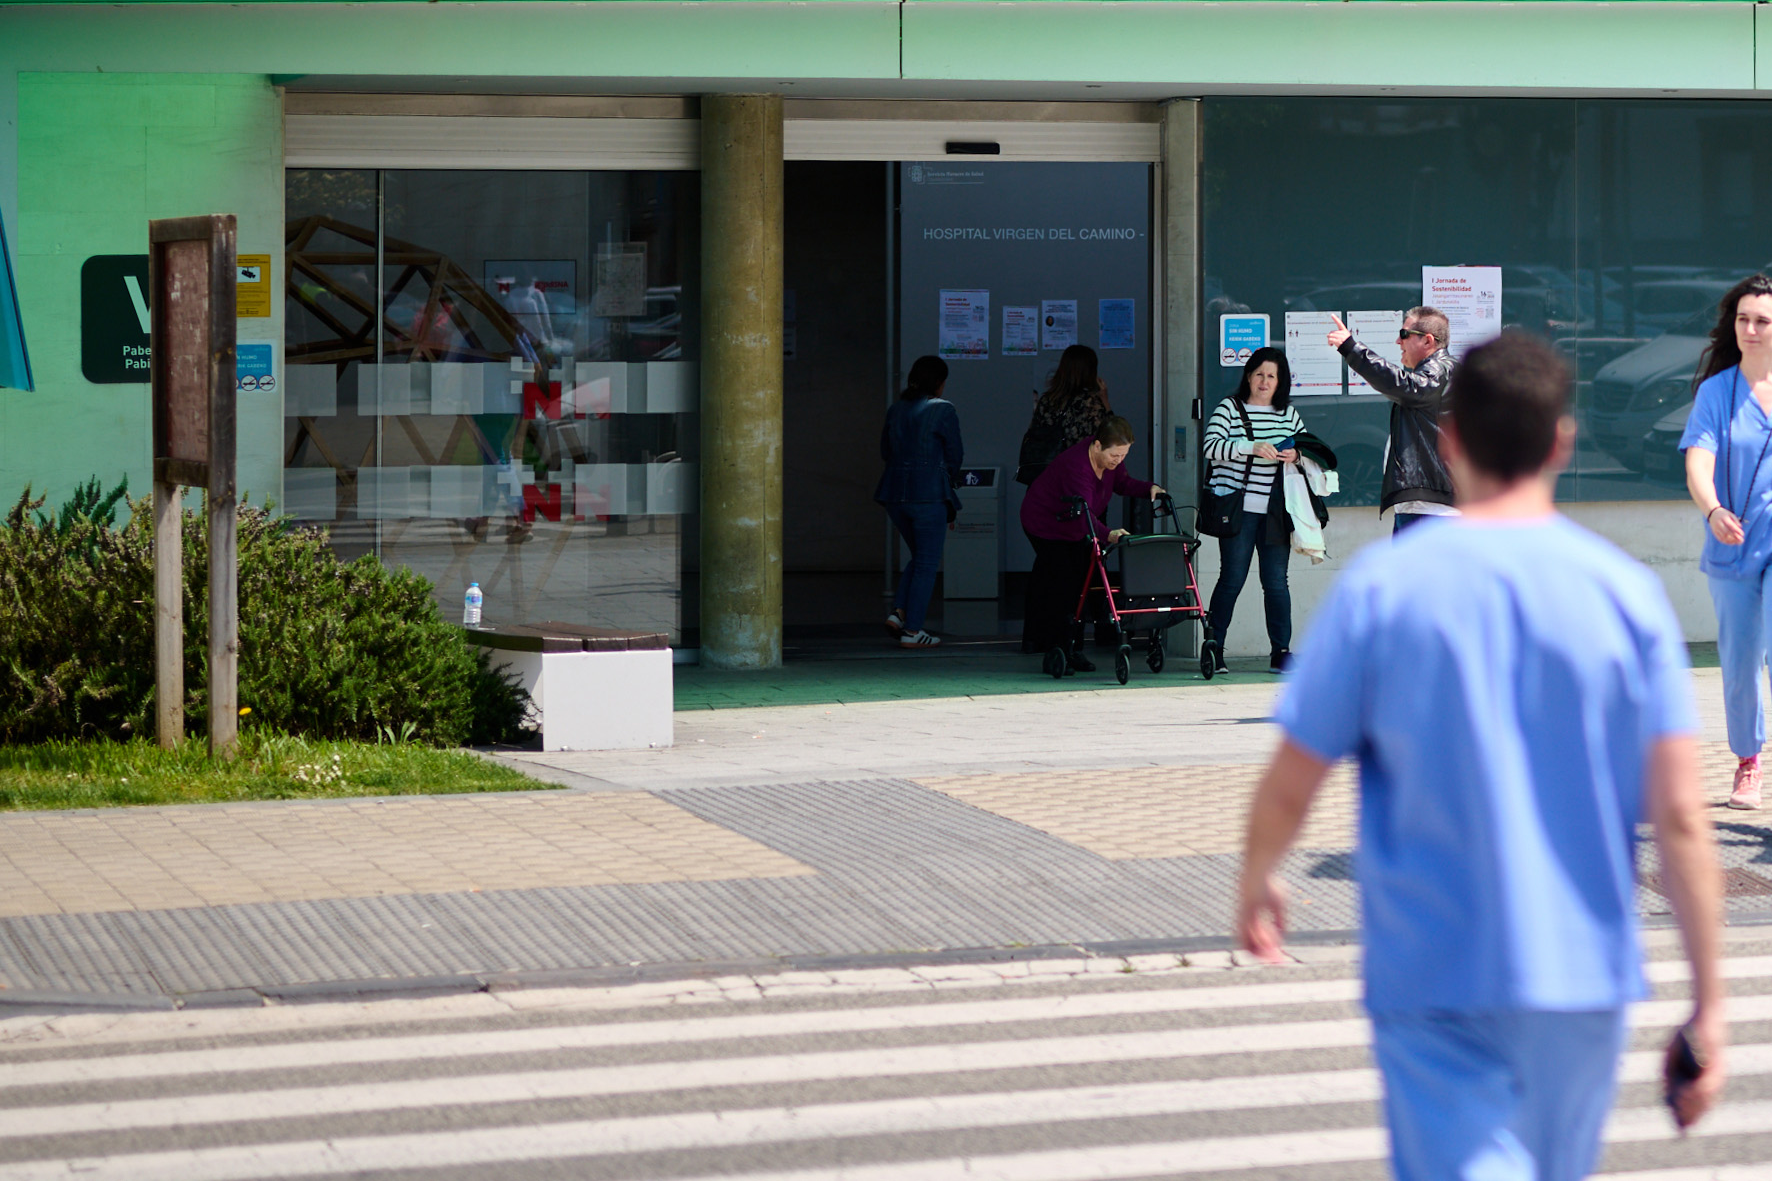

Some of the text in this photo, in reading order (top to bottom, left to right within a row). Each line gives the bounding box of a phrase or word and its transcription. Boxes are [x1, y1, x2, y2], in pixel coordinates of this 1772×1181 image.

[924, 228, 990, 240] HOSPITAL
[992, 228, 1045, 240] VIRGEN
[1049, 228, 1075, 240] DEL
[1079, 228, 1135, 240] CAMINO
[123, 345, 152, 356] Pabe
[125, 358, 151, 369] Pabi
